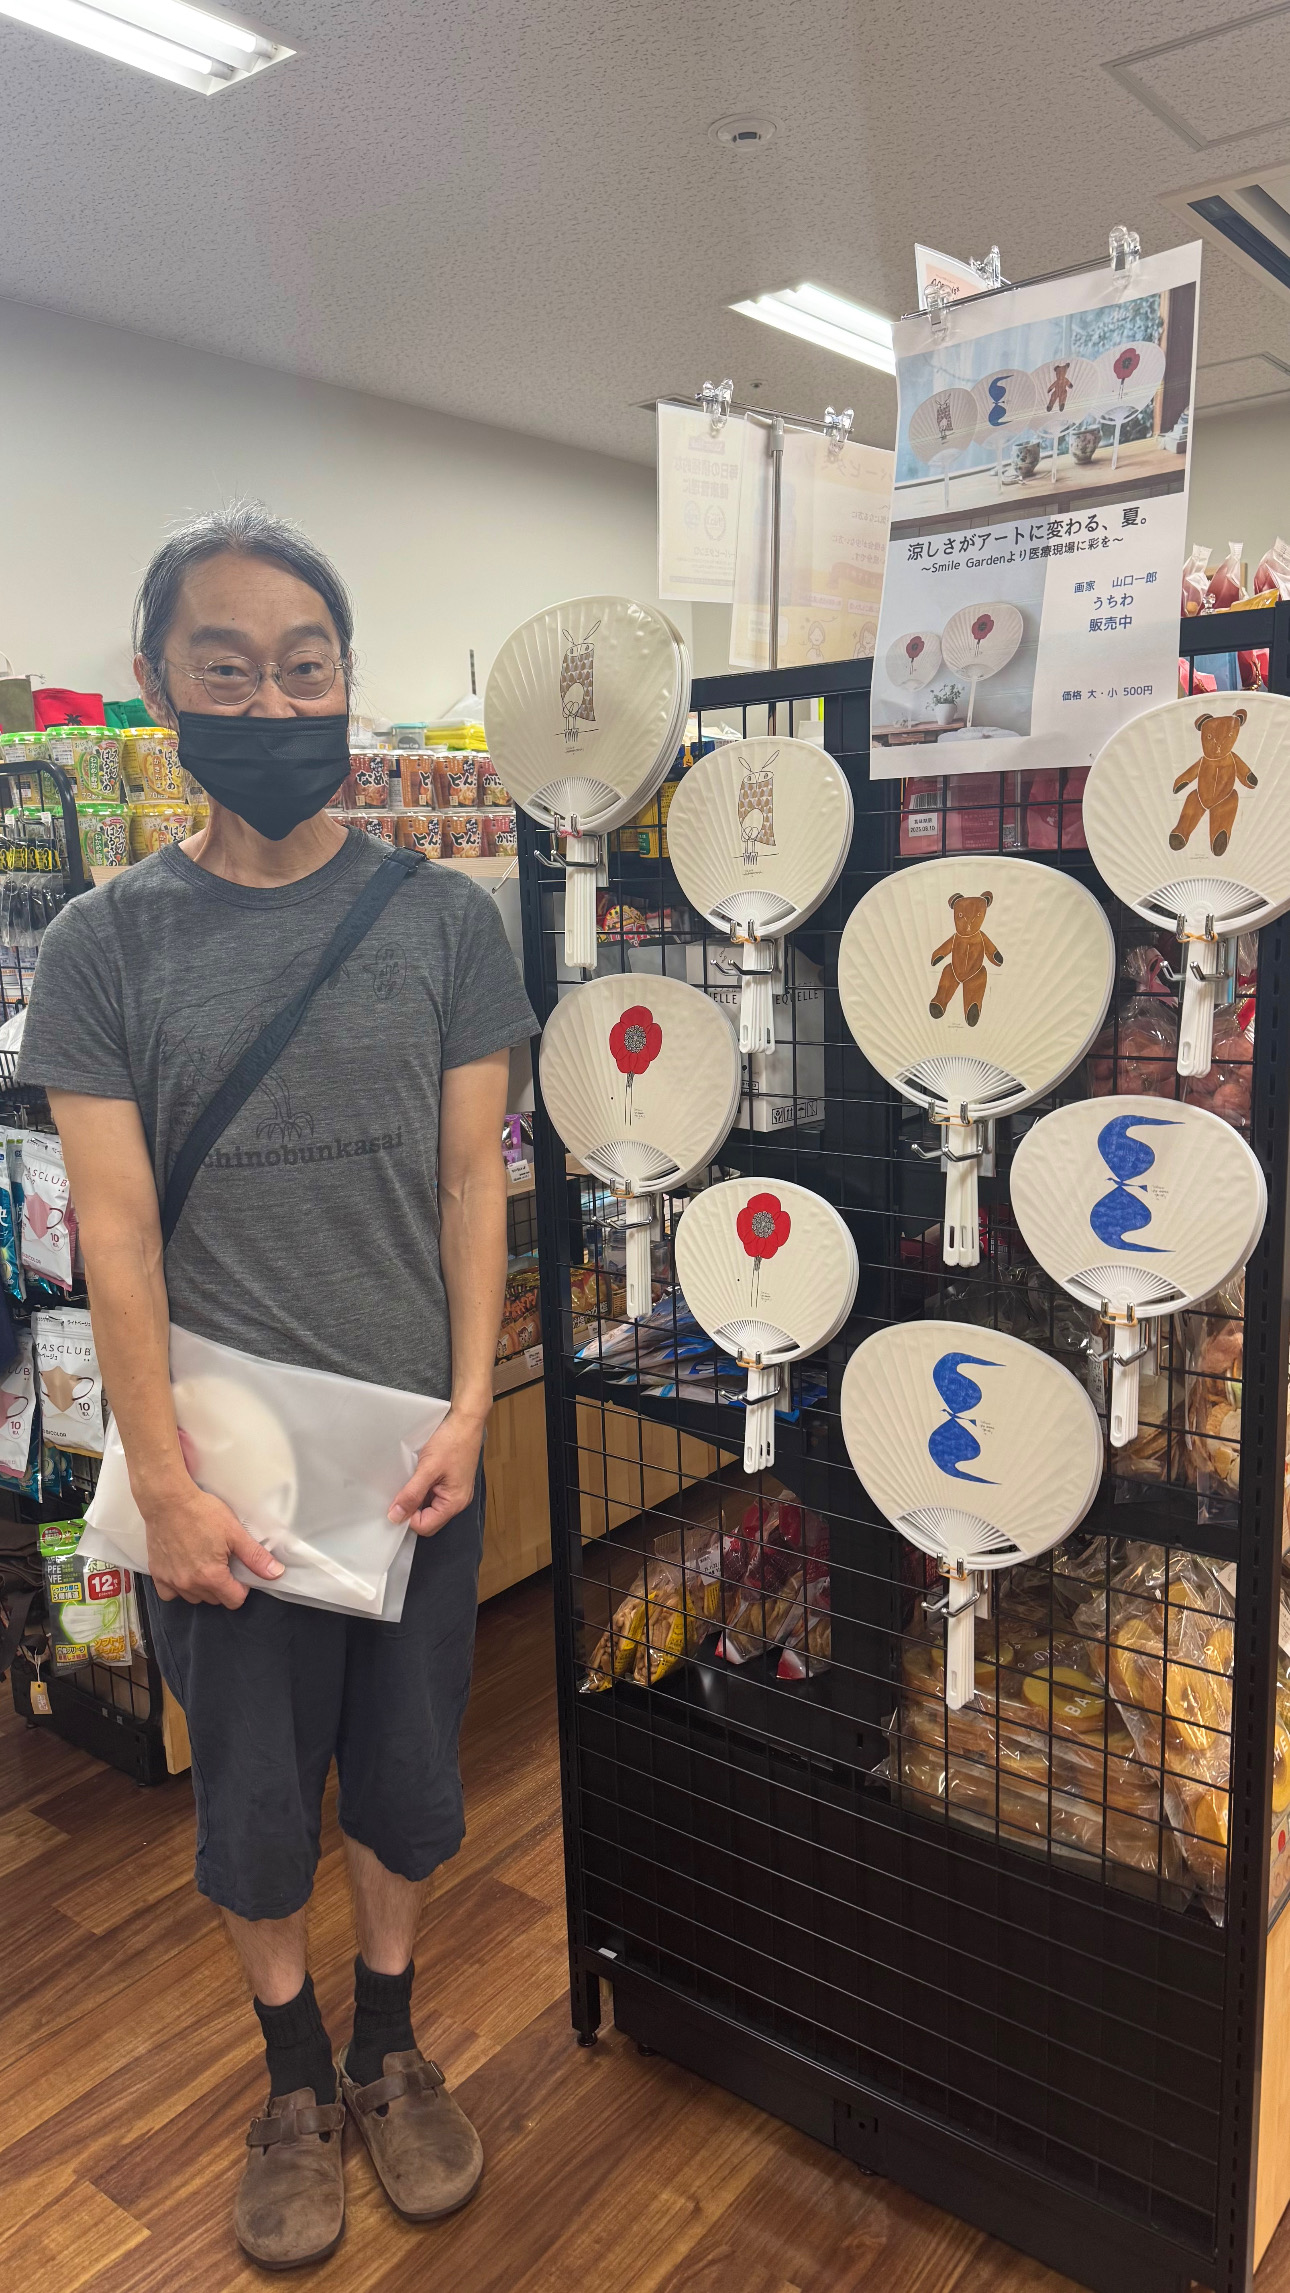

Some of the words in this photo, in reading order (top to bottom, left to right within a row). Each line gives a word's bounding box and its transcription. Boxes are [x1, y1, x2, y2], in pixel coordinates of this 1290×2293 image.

[907, 506, 1147, 562] 涼しさがアートに変わる、夏。
[1074, 580, 1096, 593] 画家
[1112, 572, 1158, 588] 山口一郎
[1093, 593, 1134, 610] うちわ
[1089, 615, 1133, 633] 販売中
[1062, 690, 1082, 701] 価格
[1123, 685, 1153, 697] 500円
[776, 990, 819, 1005] EQELLE
[26, 1166, 68, 1188] ASCLUB
[50, 1232, 60, 1243] 10
[78, 1402, 90, 1413] 10
[10, 1421, 21, 1430] 10
[47, 1565, 62, 1574] PFE
[91, 1574, 113, 1594] 12
